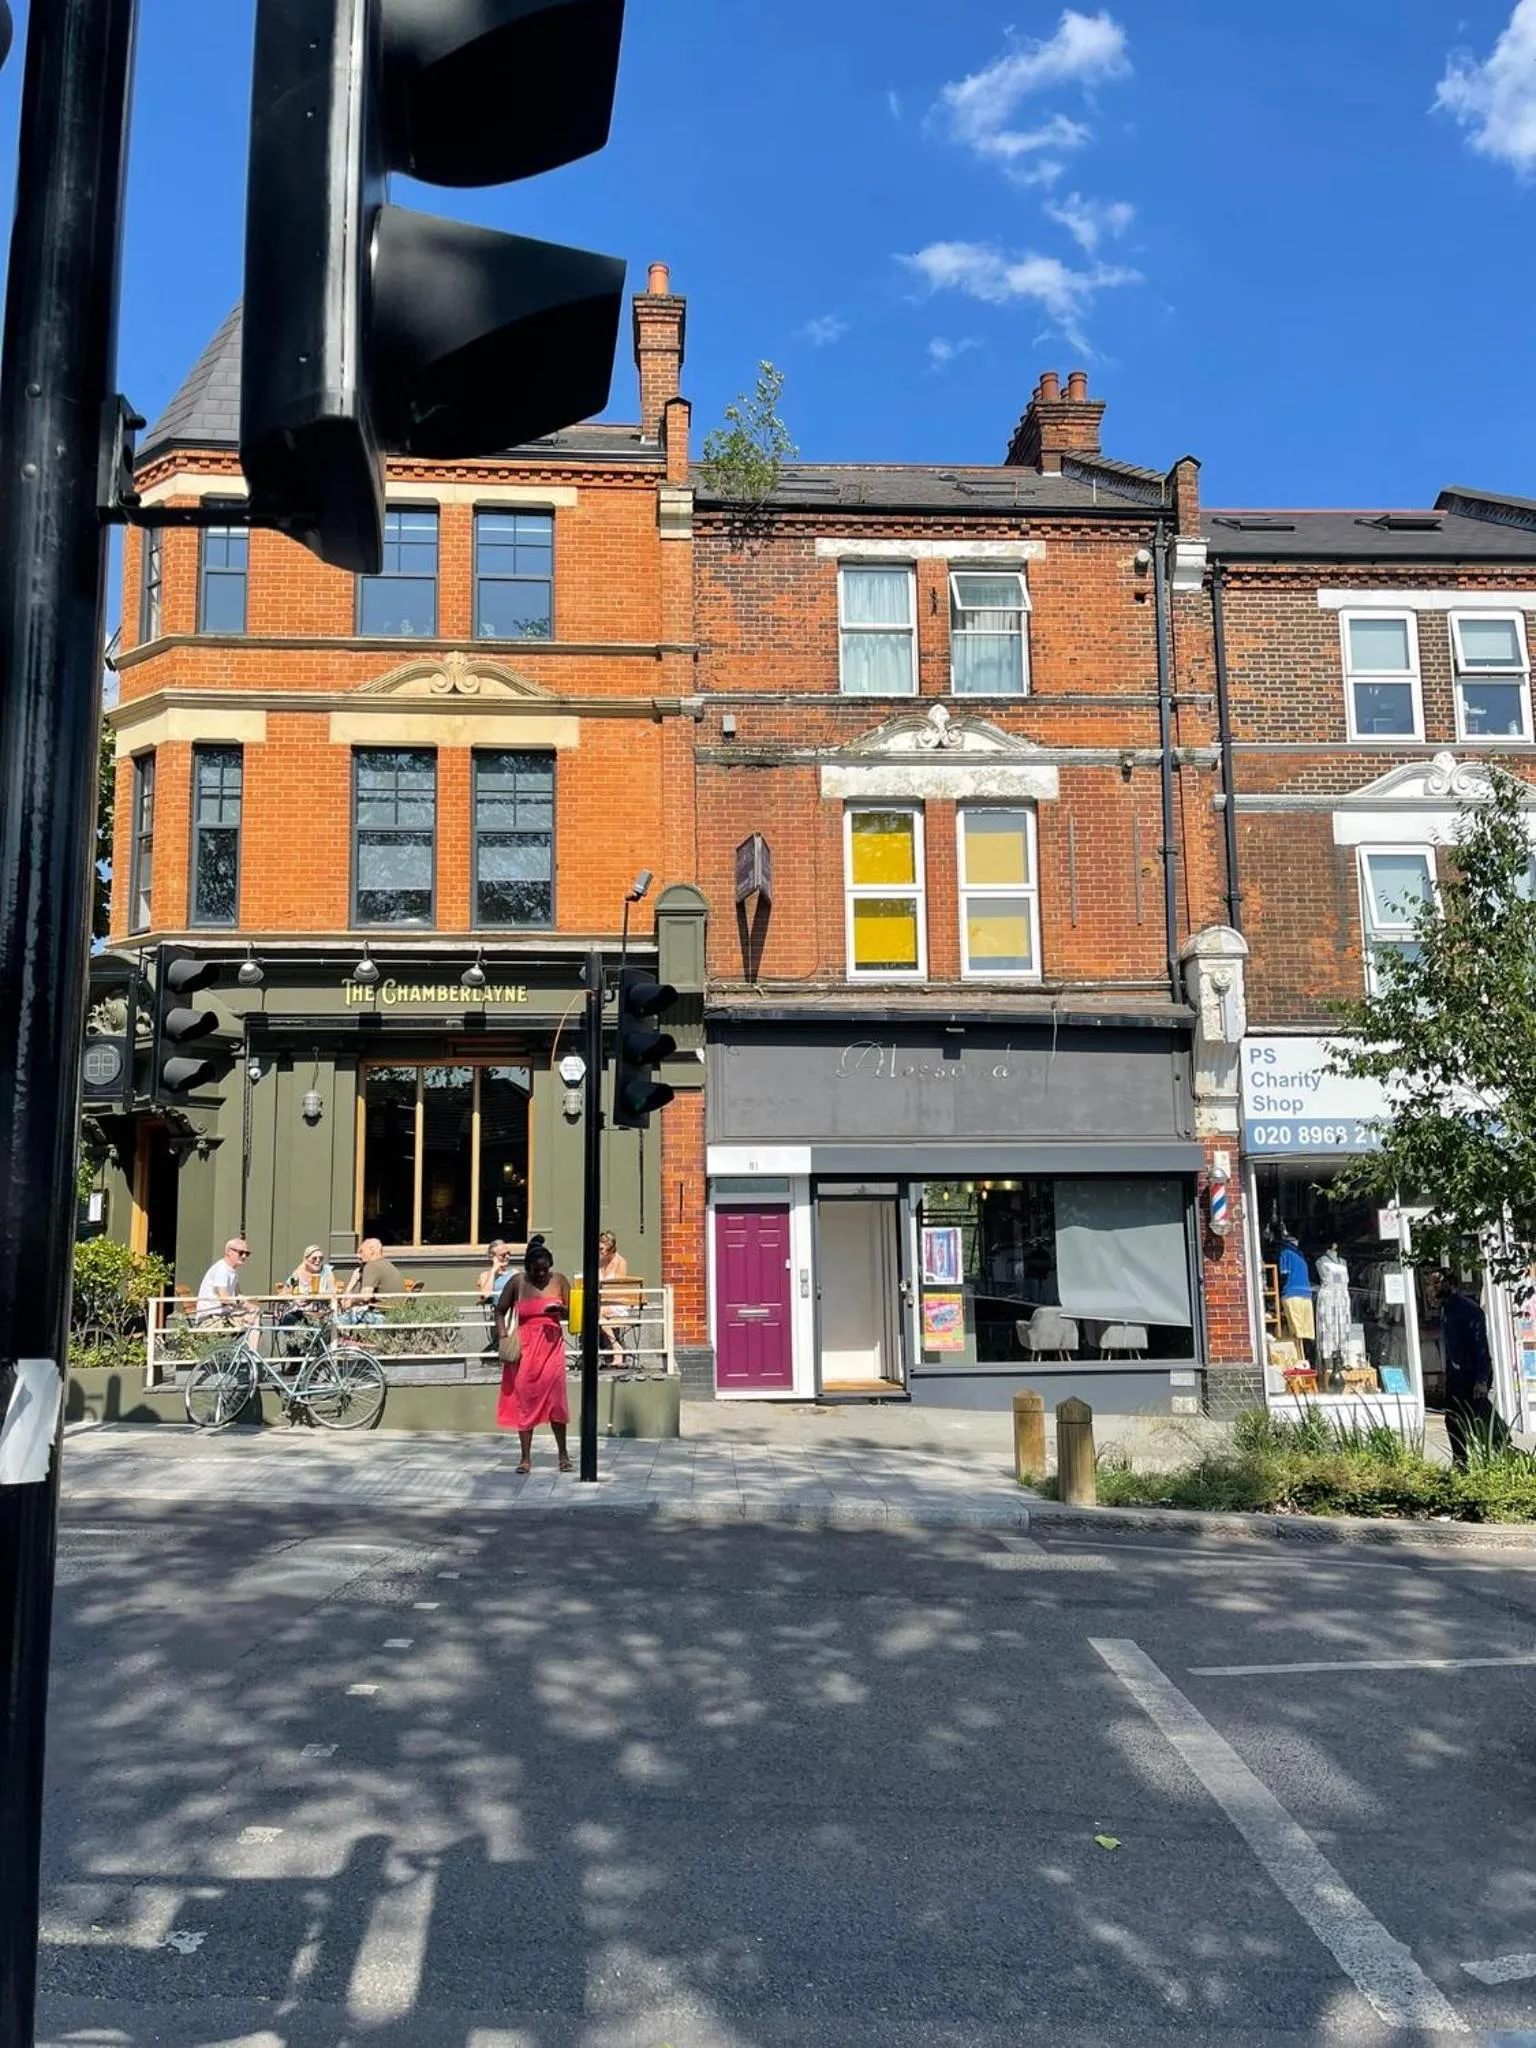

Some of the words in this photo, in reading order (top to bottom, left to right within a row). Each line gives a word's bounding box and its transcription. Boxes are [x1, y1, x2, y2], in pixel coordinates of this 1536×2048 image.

[341, 979, 376, 1008] THE
[381, 978, 528, 1005] CHAMBERLAYNE
[1249, 1048, 1277, 1064] PS
[1251, 1071, 1321, 1091] Charity
[1252, 1094, 1304, 1114] Shop
[1254, 1126, 1291, 1145] 020
[1298, 1126, 1348, 1145] 8968
